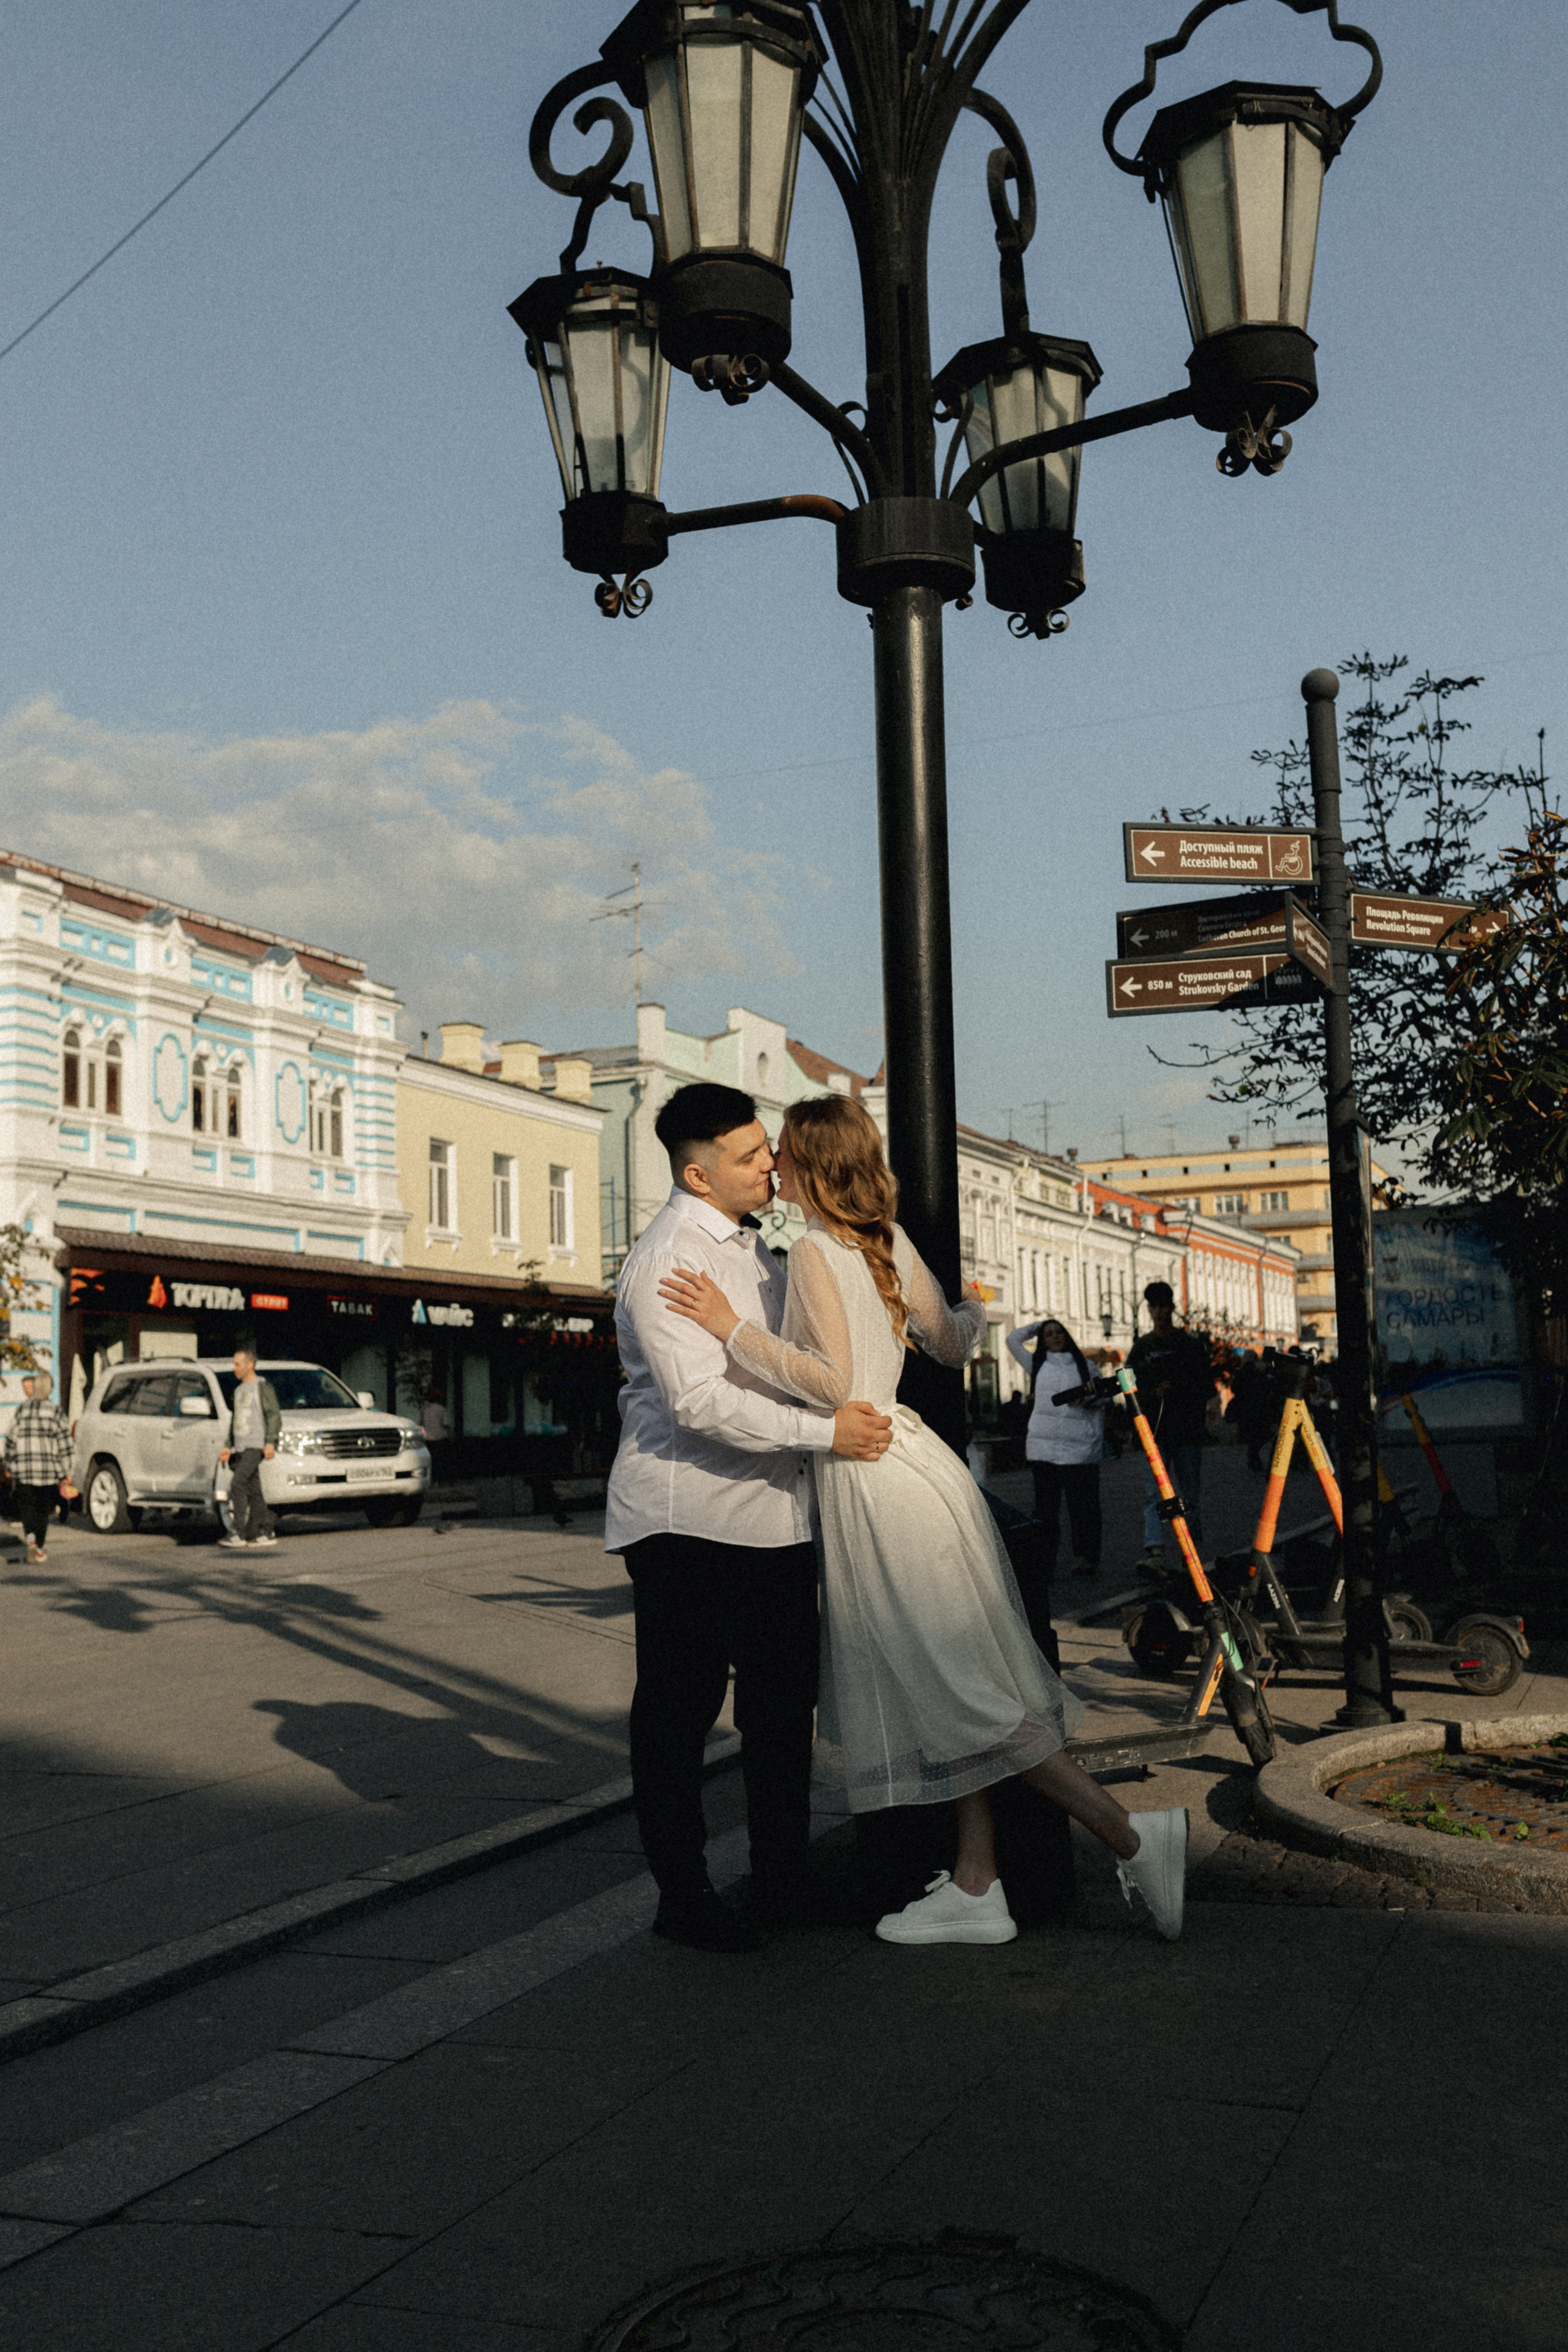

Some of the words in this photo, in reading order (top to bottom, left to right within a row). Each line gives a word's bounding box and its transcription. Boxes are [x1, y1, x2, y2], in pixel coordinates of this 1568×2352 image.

[1179, 840, 1235, 855] Доступный
[1237, 845, 1264, 854] пляж
[1180, 856, 1228, 869] Accessible
[1229, 856, 1257, 870] beach
[1366, 906, 1401, 921] Площадь
[1402, 910, 1444, 925] Революции
[1155, 930, 1170, 940] 200
[1228, 928, 1251, 939] Church
[1252, 927, 1259, 935] of
[1260, 926, 1270, 935] St.
[1270, 925, 1286, 933] Geor
[1366, 919, 1406, 933] Revolution
[1406, 923, 1431, 937] Square
[1178, 969, 1234, 984] Струковский
[1235, 969, 1252, 979] сад
[1147, 980, 1164, 990] 850
[1165, 981, 1173, 990] м
[1179, 983, 1226, 996] Strukovsky
[1227, 981, 1259, 992] Garden
[1385, 1283, 1504, 1308] ГОРДОСТЬ
[331, 1300, 374, 1316] ТАБАК
[1386, 1308, 1485, 1329] САМАРЫ
[1273, 1425, 1286, 1468] WHOOSH
